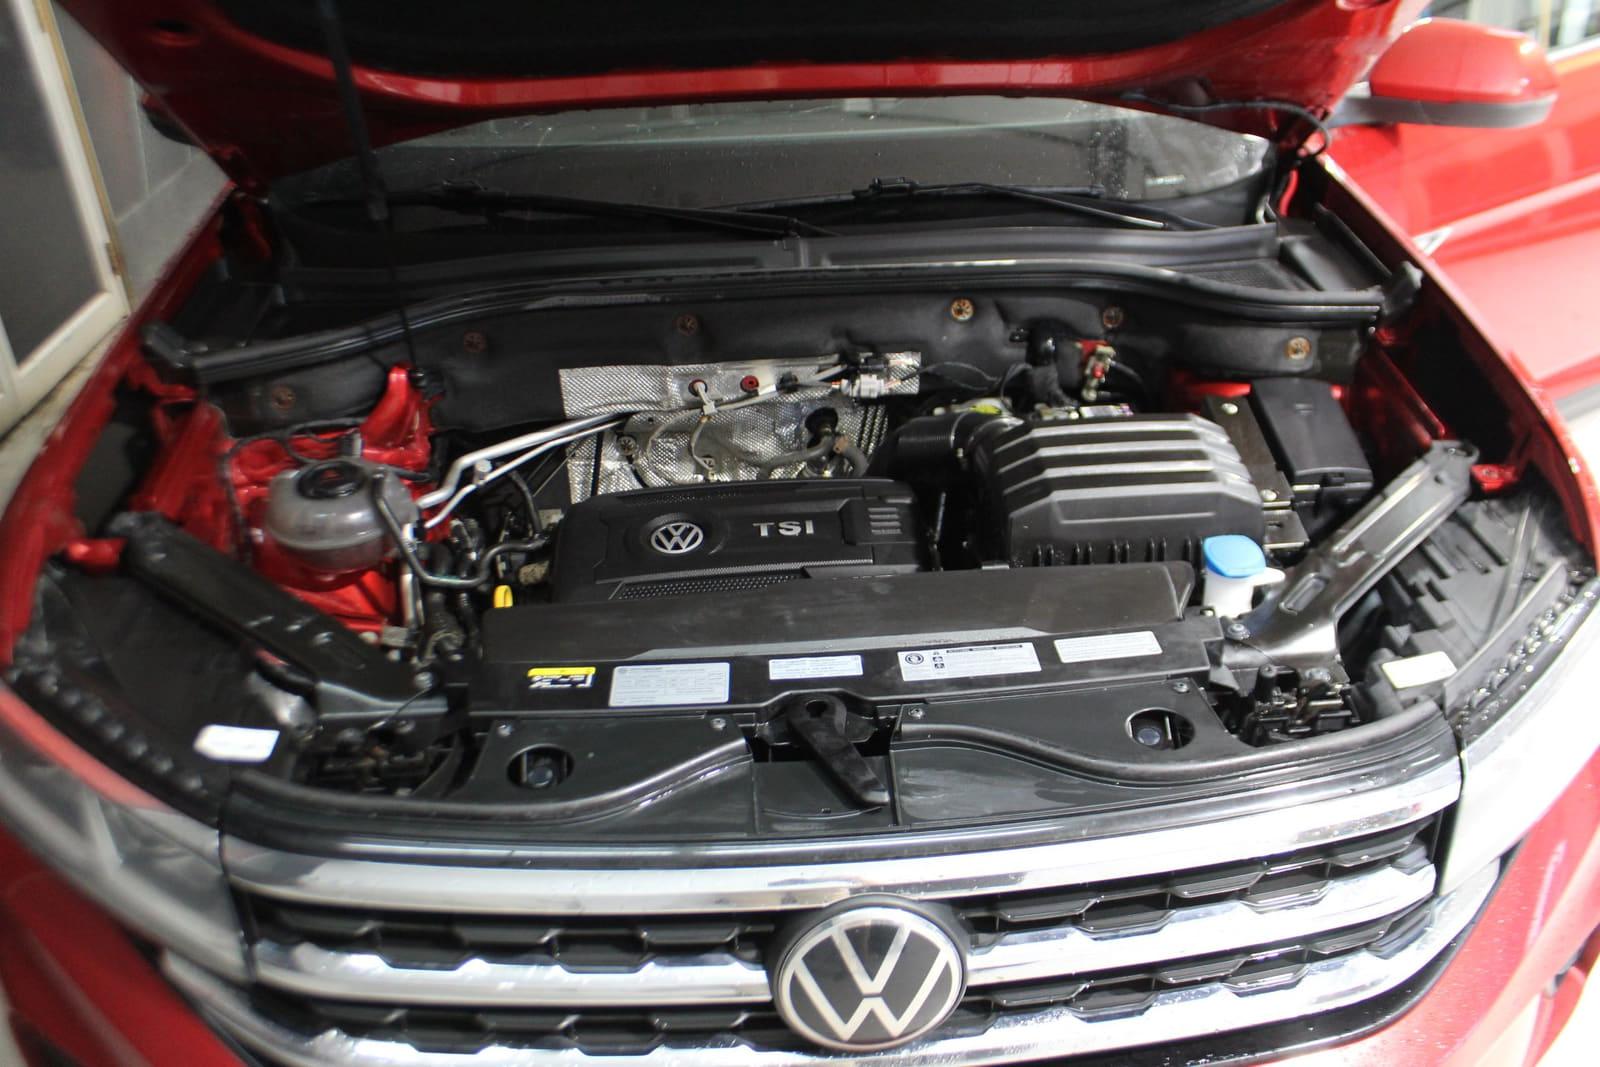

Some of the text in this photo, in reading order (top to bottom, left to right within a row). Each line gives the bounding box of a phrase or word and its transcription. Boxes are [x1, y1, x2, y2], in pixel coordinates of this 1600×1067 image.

[652, 522, 702, 553] VW
[752, 519, 815, 537] TSI
[783, 912, 957, 1045] VW
